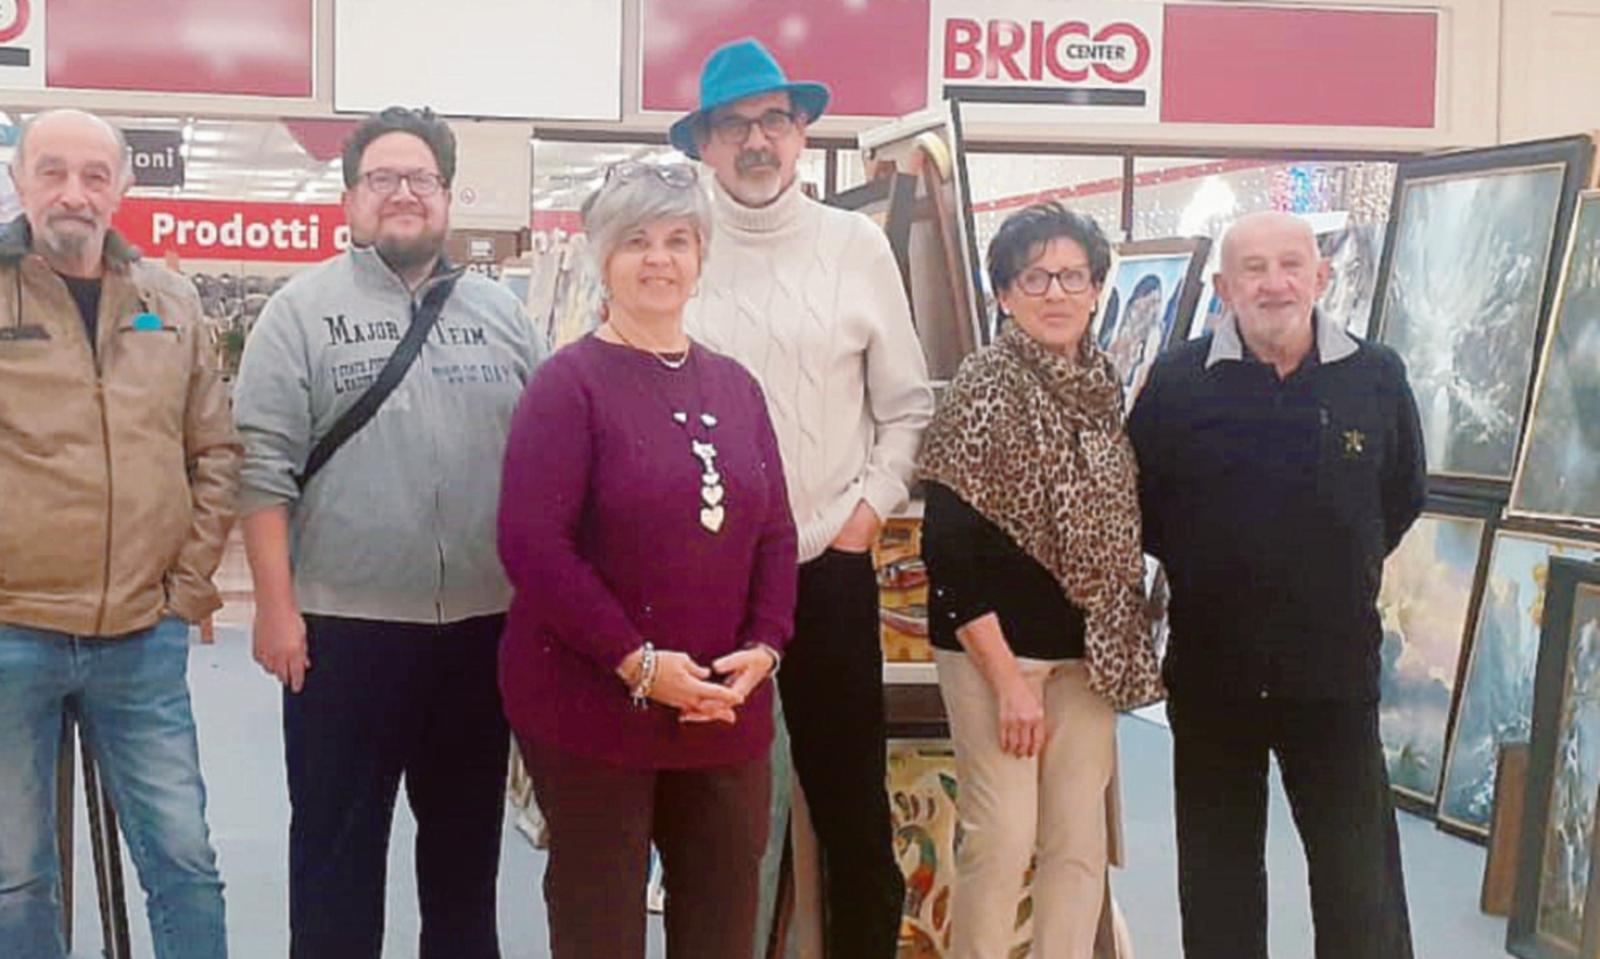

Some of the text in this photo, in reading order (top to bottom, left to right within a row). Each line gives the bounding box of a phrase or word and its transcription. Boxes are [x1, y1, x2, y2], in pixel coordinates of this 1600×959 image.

[943, 18, 1150, 83] BRICO
[1066, 44, 1126, 60] CENTER
[152, 212, 320, 249] Prodotti
